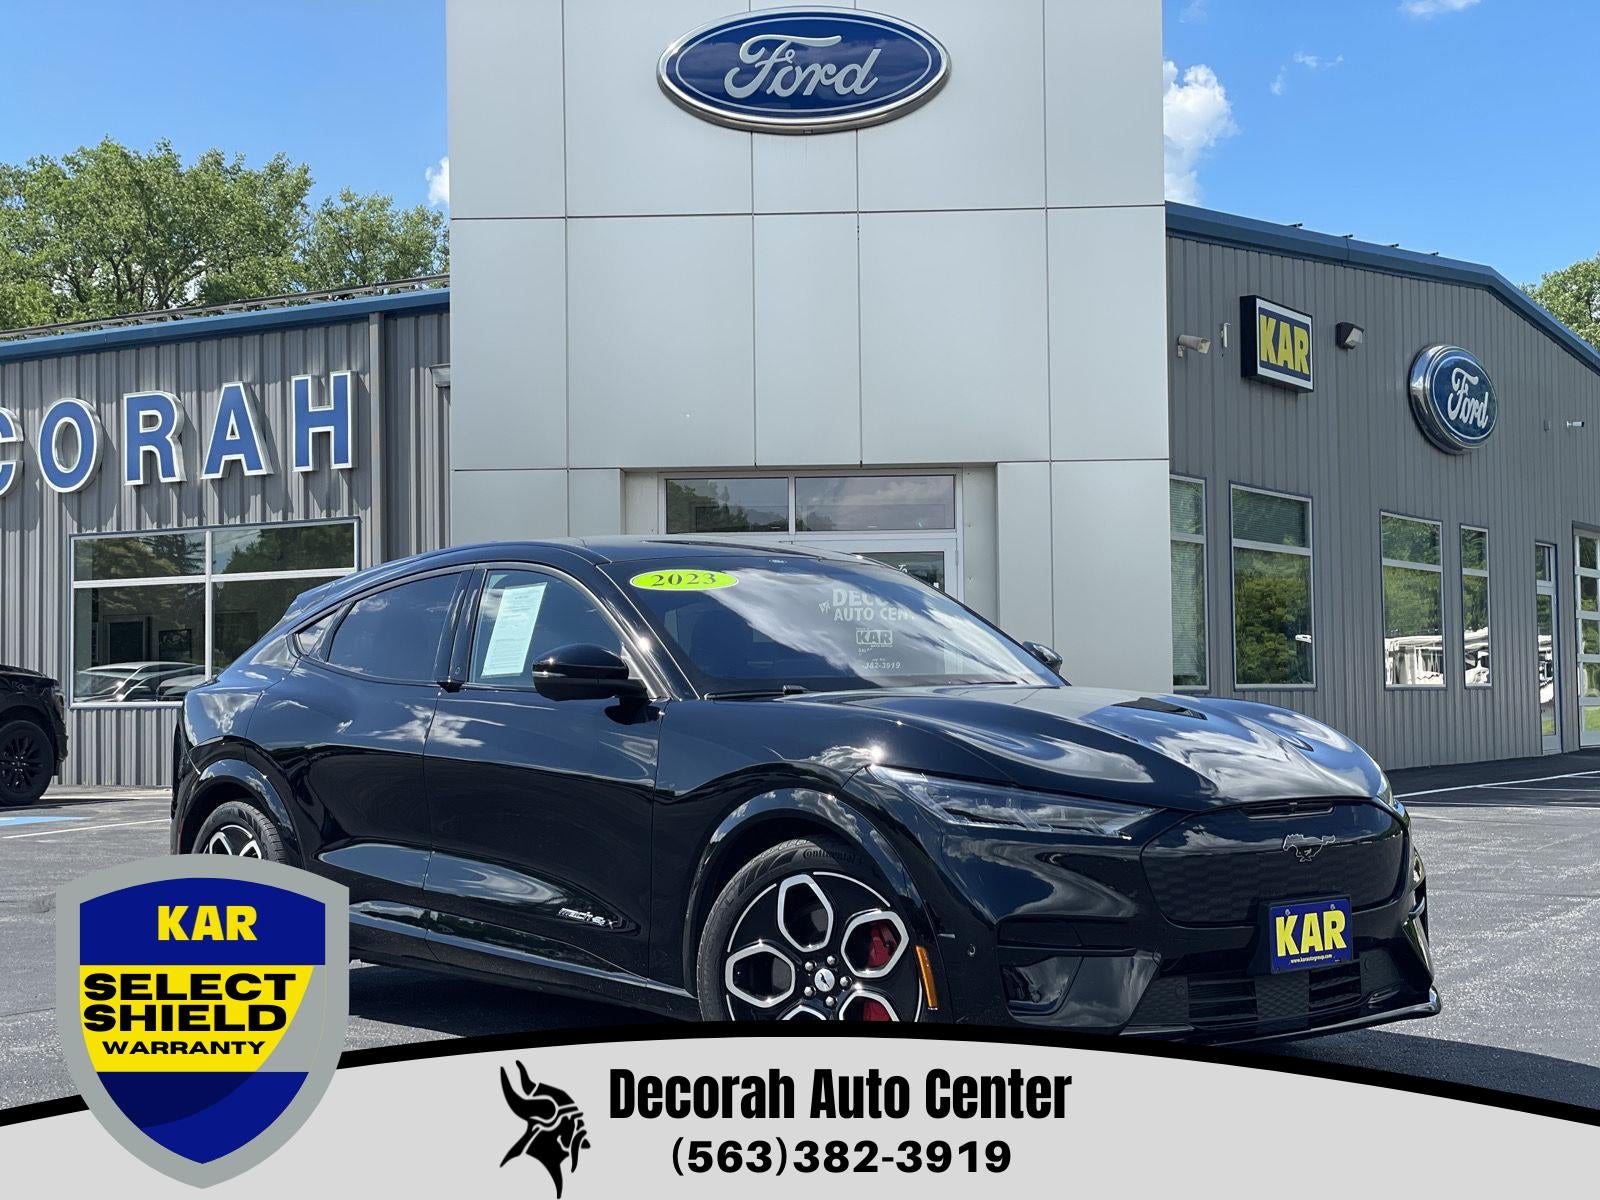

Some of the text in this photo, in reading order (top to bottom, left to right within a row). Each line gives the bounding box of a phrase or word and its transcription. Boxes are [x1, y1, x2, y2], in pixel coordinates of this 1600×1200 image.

[723, 33, 883, 99] Ford
[1259, 314, 1310, 374] KAR
[1447, 367, 1489, 429] Ford
[651, 572, 716, 587] 2023
[833, 607, 874, 622] AUTO
[857, 631, 892, 644] KAR
[1275, 909, 1347, 957] KAR
